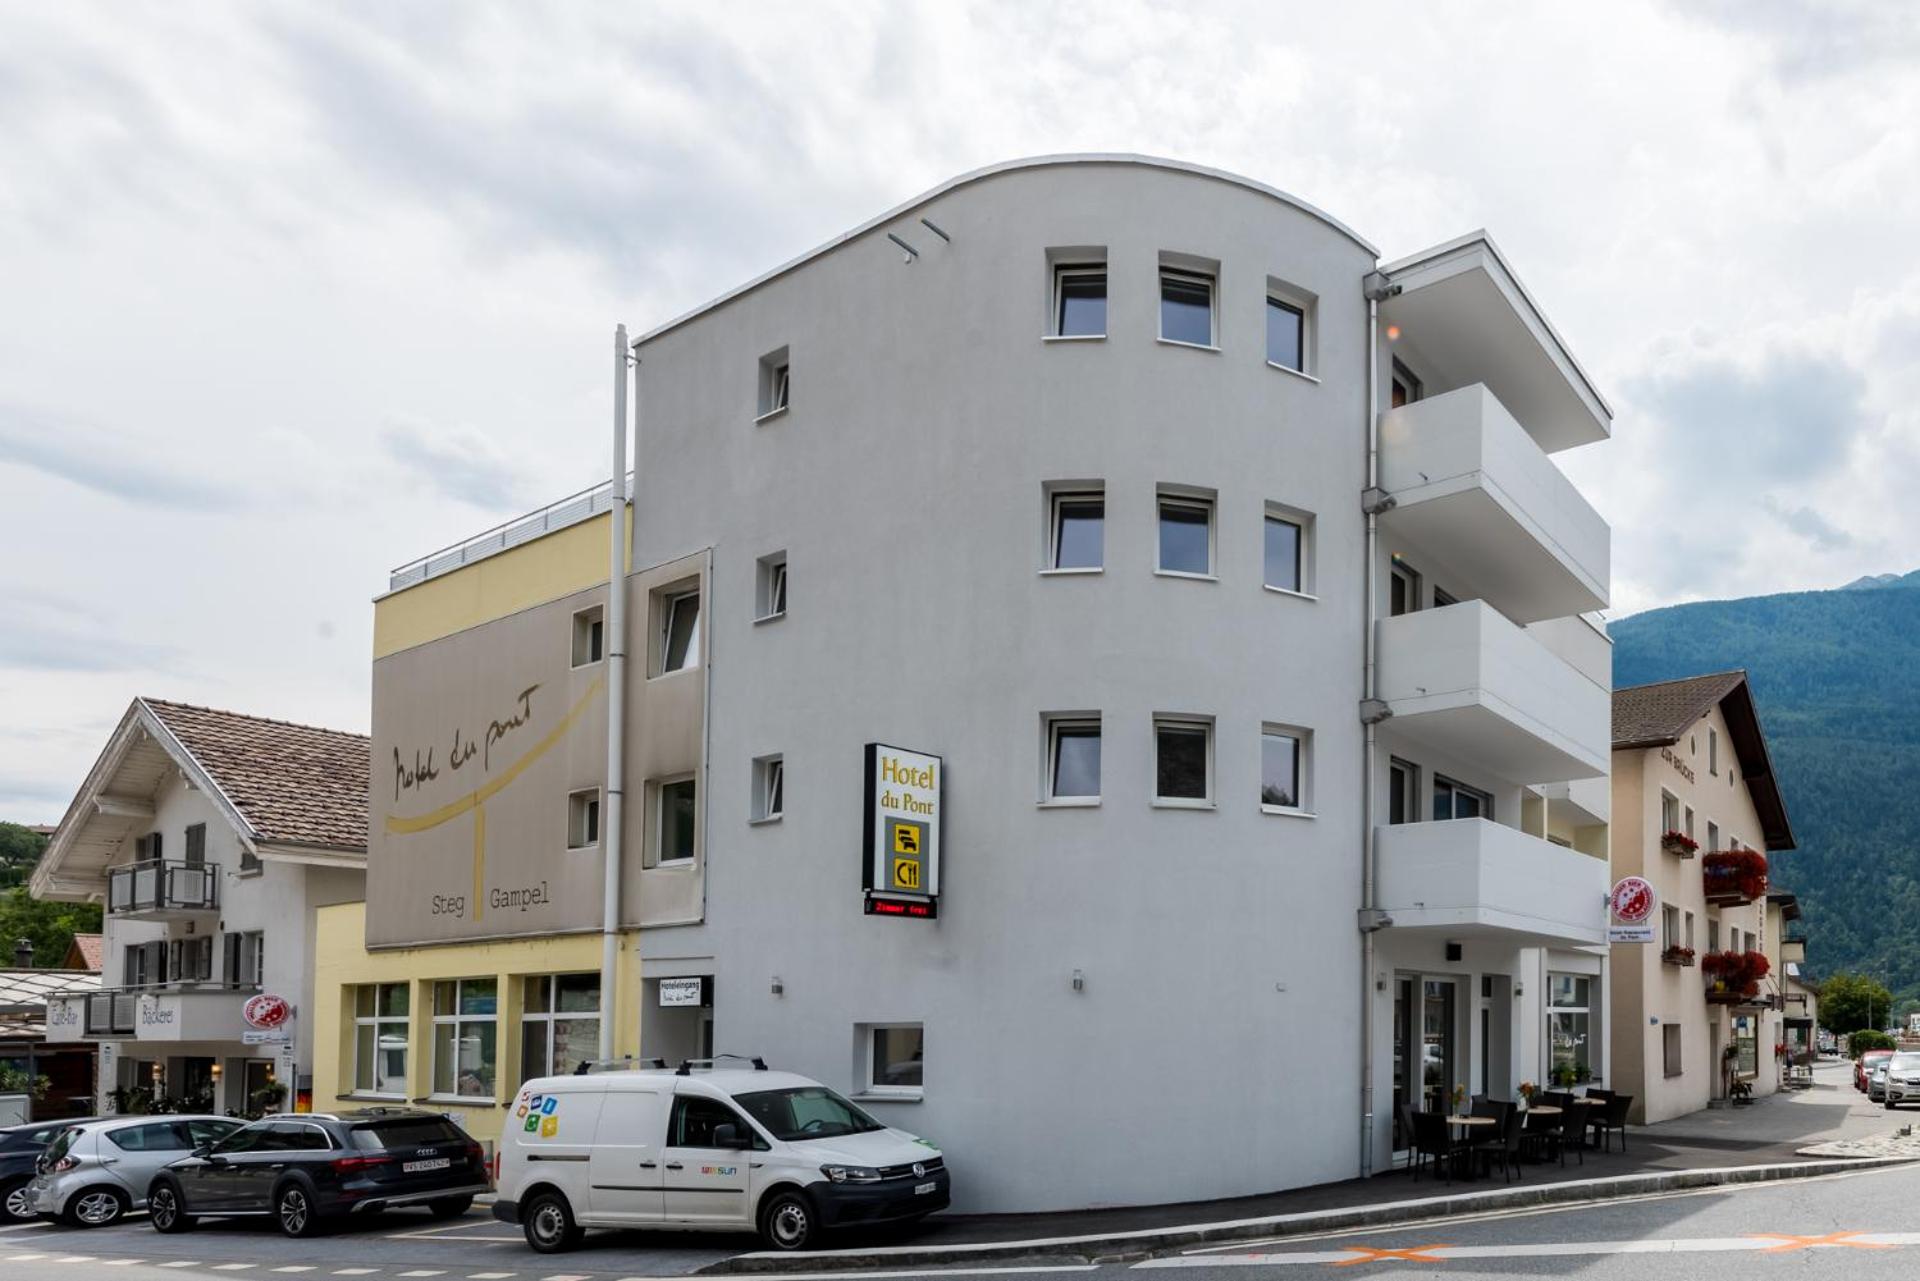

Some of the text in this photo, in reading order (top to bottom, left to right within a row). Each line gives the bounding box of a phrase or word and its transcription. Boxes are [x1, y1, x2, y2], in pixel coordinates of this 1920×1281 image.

[881, 757, 934, 790] Hotel
[881, 790, 934, 815] du Pont
[431, 881, 550, 918] Steg Gampel
